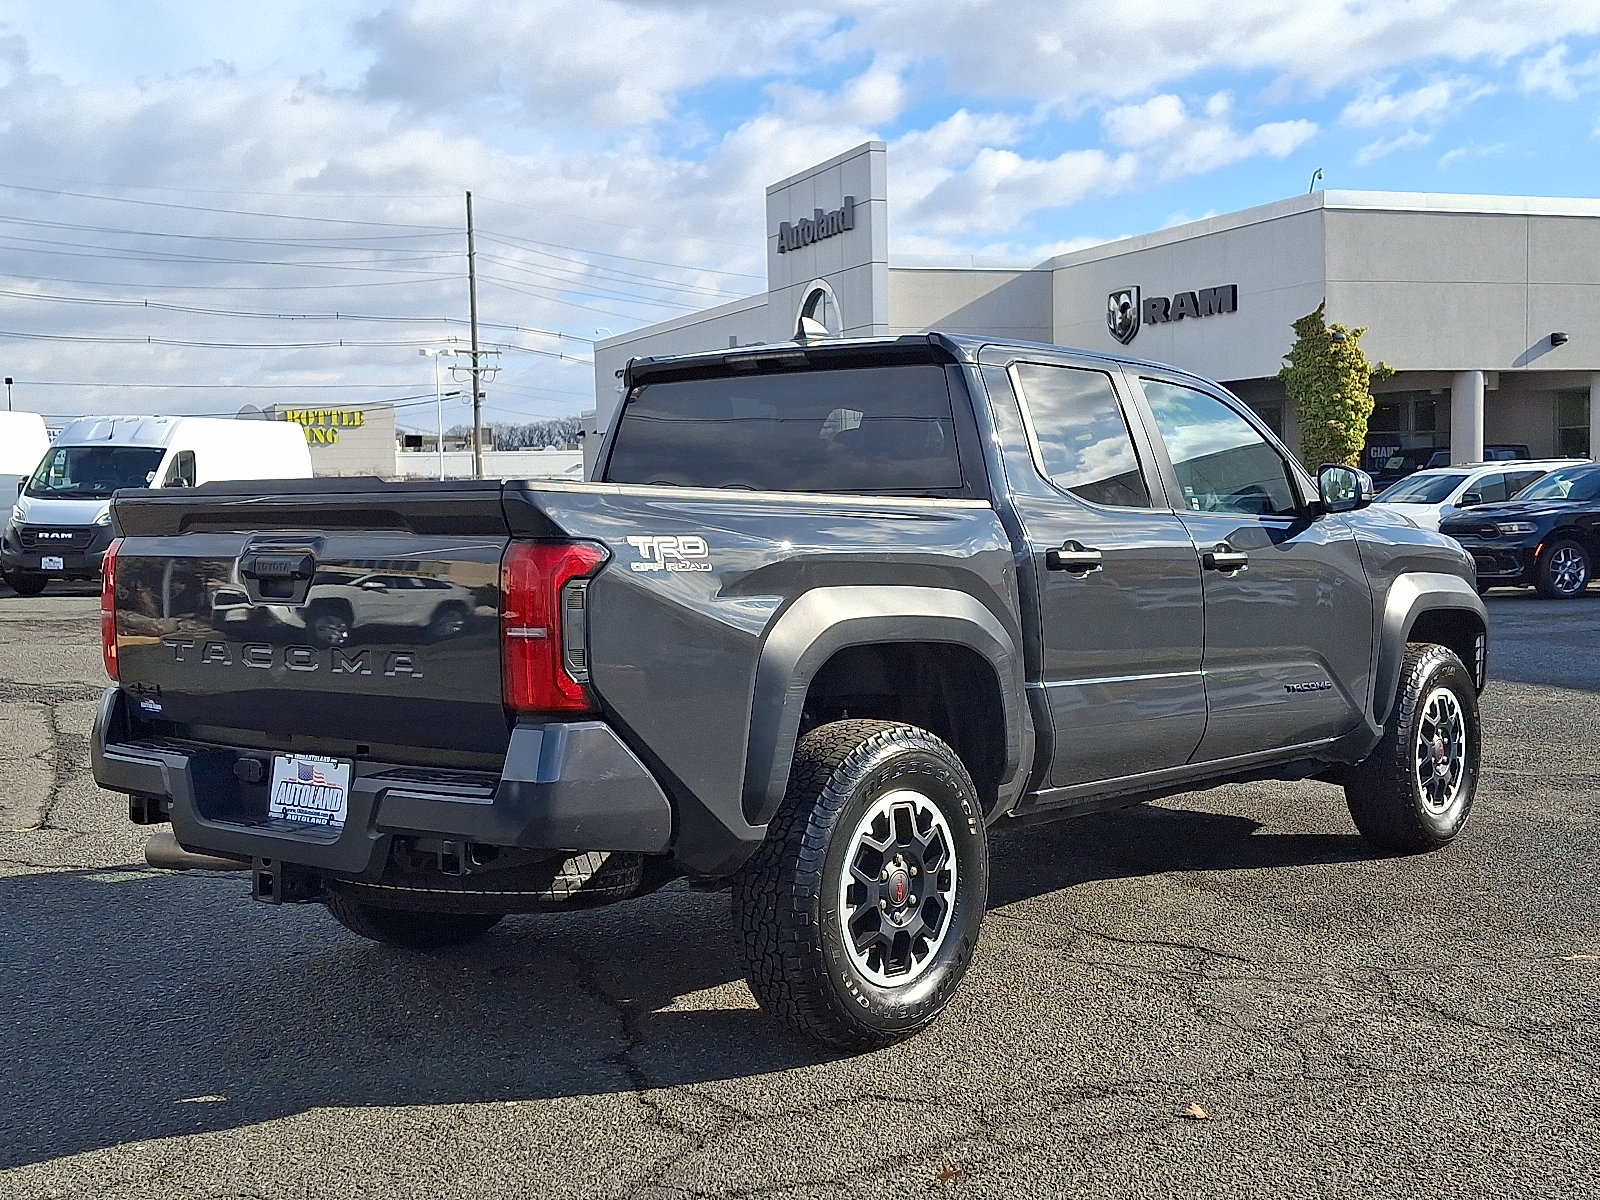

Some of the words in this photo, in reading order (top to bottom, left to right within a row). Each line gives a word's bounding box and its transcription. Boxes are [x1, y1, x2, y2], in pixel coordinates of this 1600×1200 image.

[777, 195, 853, 254] Autoland
[1143, 284, 1238, 325] RAM
[285, 410, 365, 426] BOTTLE
[303, 427, 339, 443] ING
[626, 535, 709, 563] TRD
[258, 561, 290, 574] TOYOTA
[163, 639, 423, 678] TACOMA
[1283, 681, 1332, 693] TACOMA
[275, 781, 344, 812] AUTOLAND
[285, 814, 328, 825] AUTOLAND
